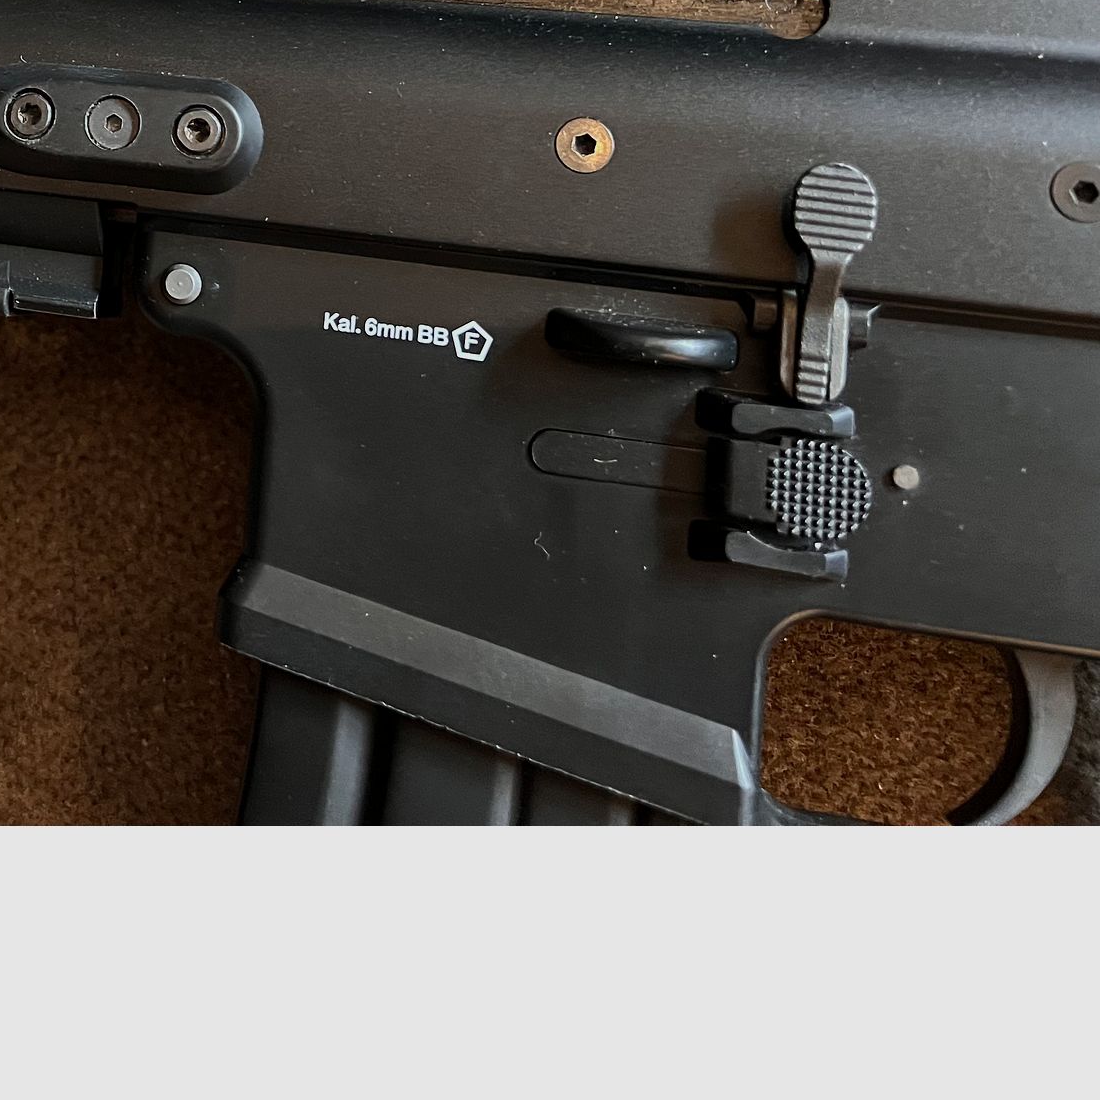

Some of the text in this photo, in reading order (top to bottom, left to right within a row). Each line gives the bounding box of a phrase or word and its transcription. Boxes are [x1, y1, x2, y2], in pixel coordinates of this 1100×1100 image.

[323, 311, 449, 347] Kal. 6mm BB
[463, 331, 480, 350] F
